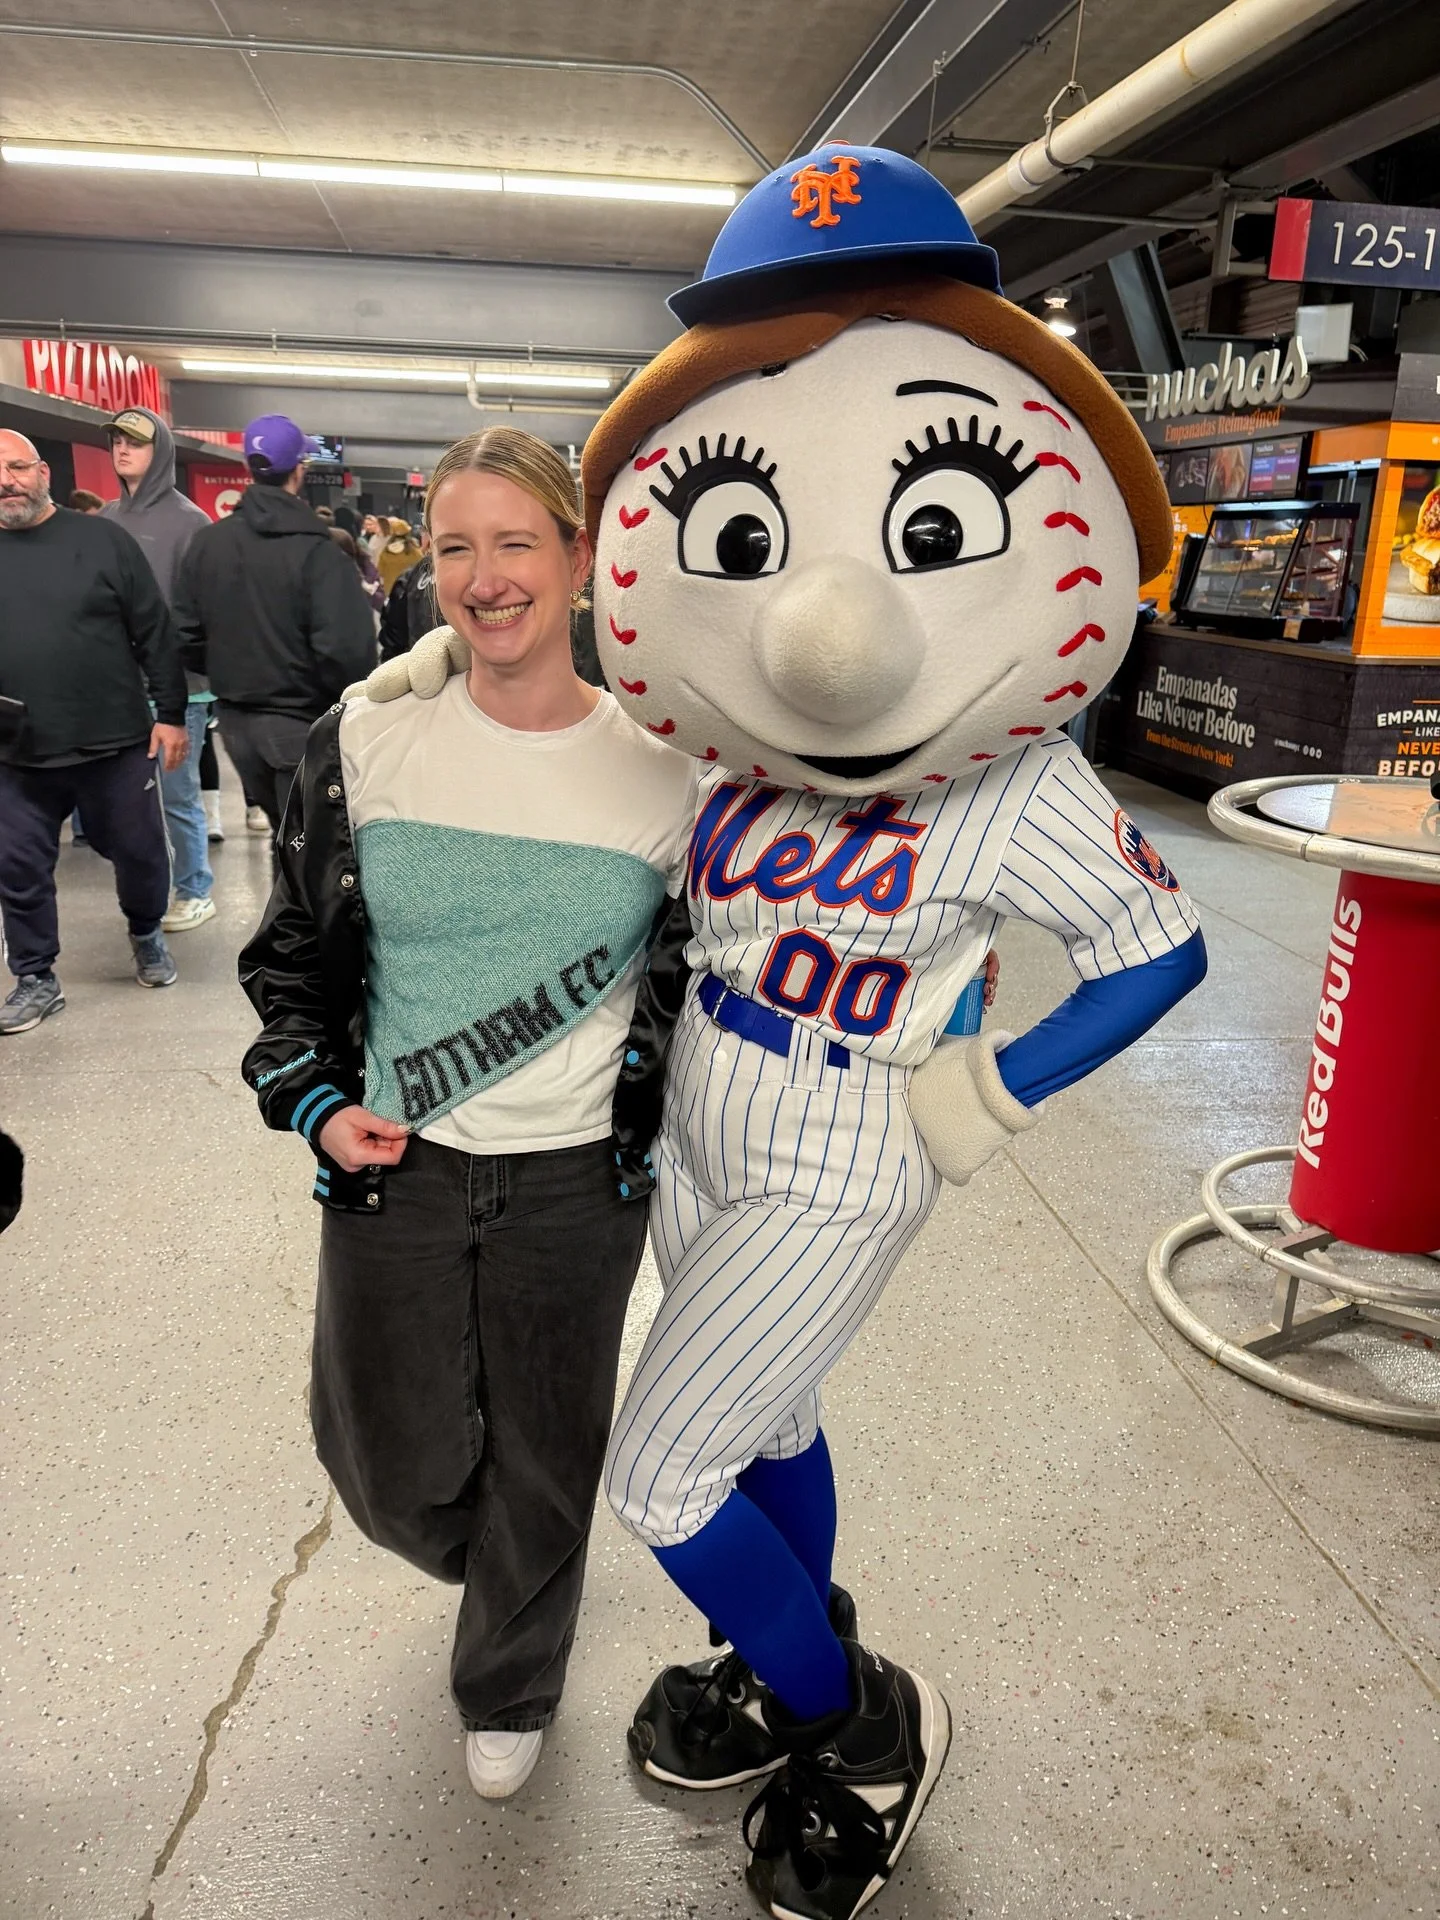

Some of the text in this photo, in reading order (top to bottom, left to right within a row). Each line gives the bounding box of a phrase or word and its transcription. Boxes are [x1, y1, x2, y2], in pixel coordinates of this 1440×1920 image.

[1333, 221, 1436, 271] 125-1
[1144, 335, 1311, 422] nuchas
[1164, 404, 1281, 446] Empanadas Reimagined
[1156, 665, 1238, 711] Empanadas
[1136, 690, 1256, 749] Like Never Before
[1377, 709, 1440, 727] EMPAN
[1415, 726, 1440, 737] LIKE
[1146, 728, 1161, 745] From
[1200, 746, 1214, 761] New
[1215, 749, 1234, 768] York!
[1377, 759, 1440, 777] BEFO
[687, 781, 929, 917] Mets
[758, 927, 912, 1036] 00
[393, 944, 614, 1122] GOTHAM FC
[1298, 895, 1362, 1170] Red Bulls
